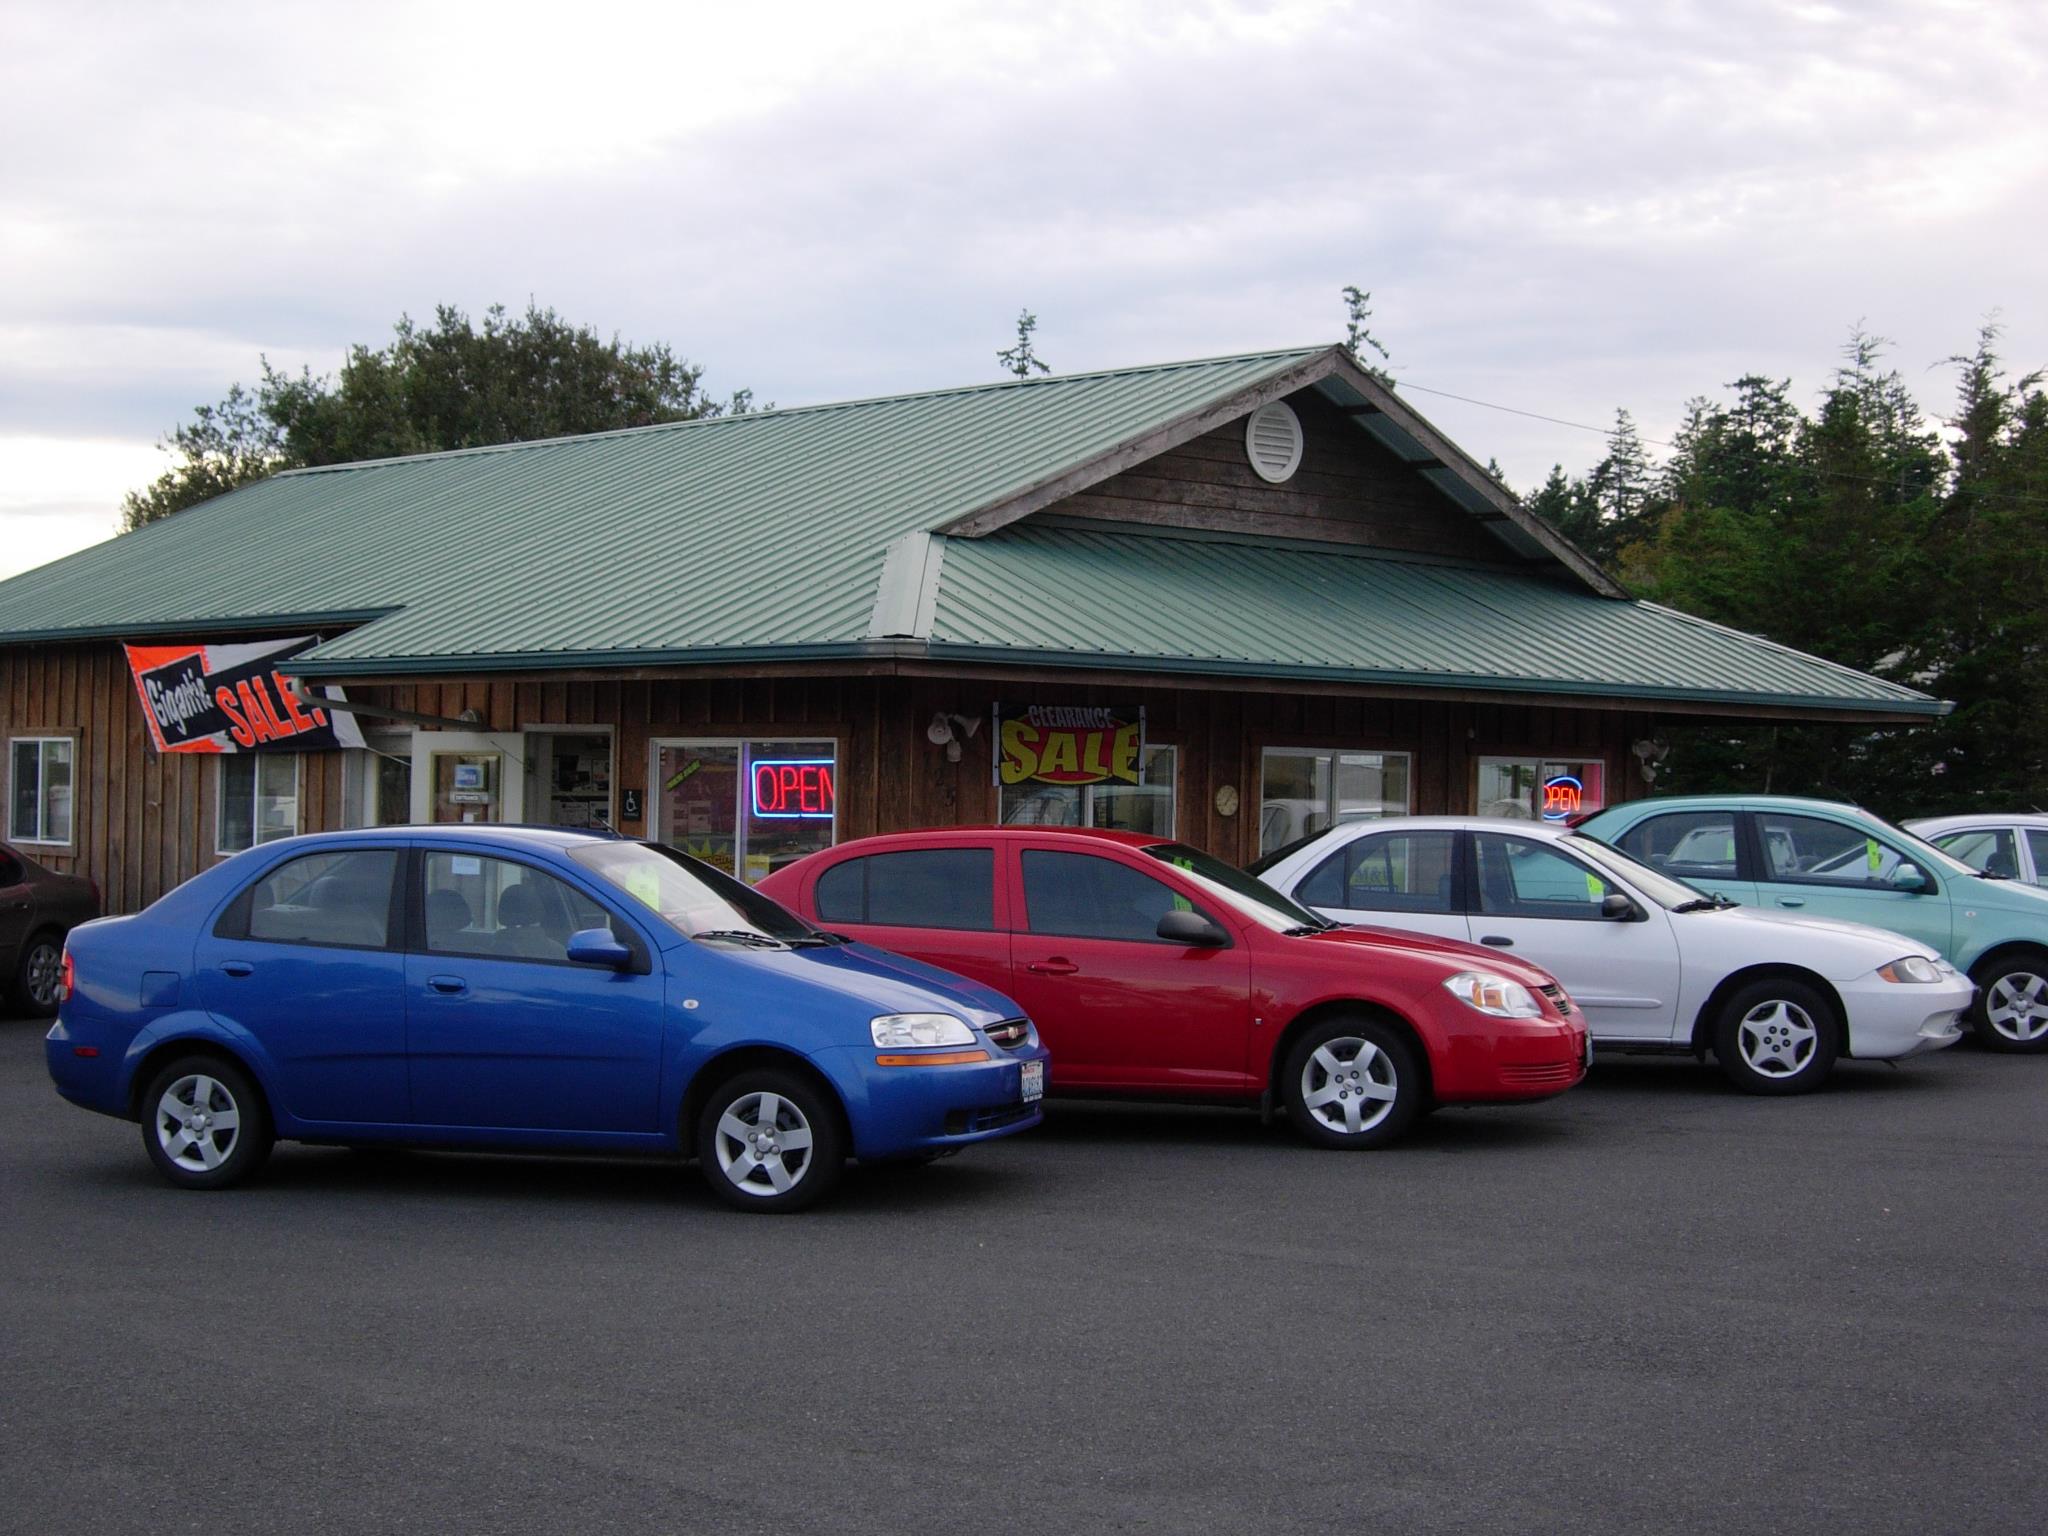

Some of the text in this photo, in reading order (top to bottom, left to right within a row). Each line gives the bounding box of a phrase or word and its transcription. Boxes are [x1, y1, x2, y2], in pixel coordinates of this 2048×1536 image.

[145, 667, 215, 736] Gigantic
[1027, 704, 1116, 728] CLEARANCE
[1000, 719, 1140, 785] SALE
[756, 765, 835, 812] OPEN
